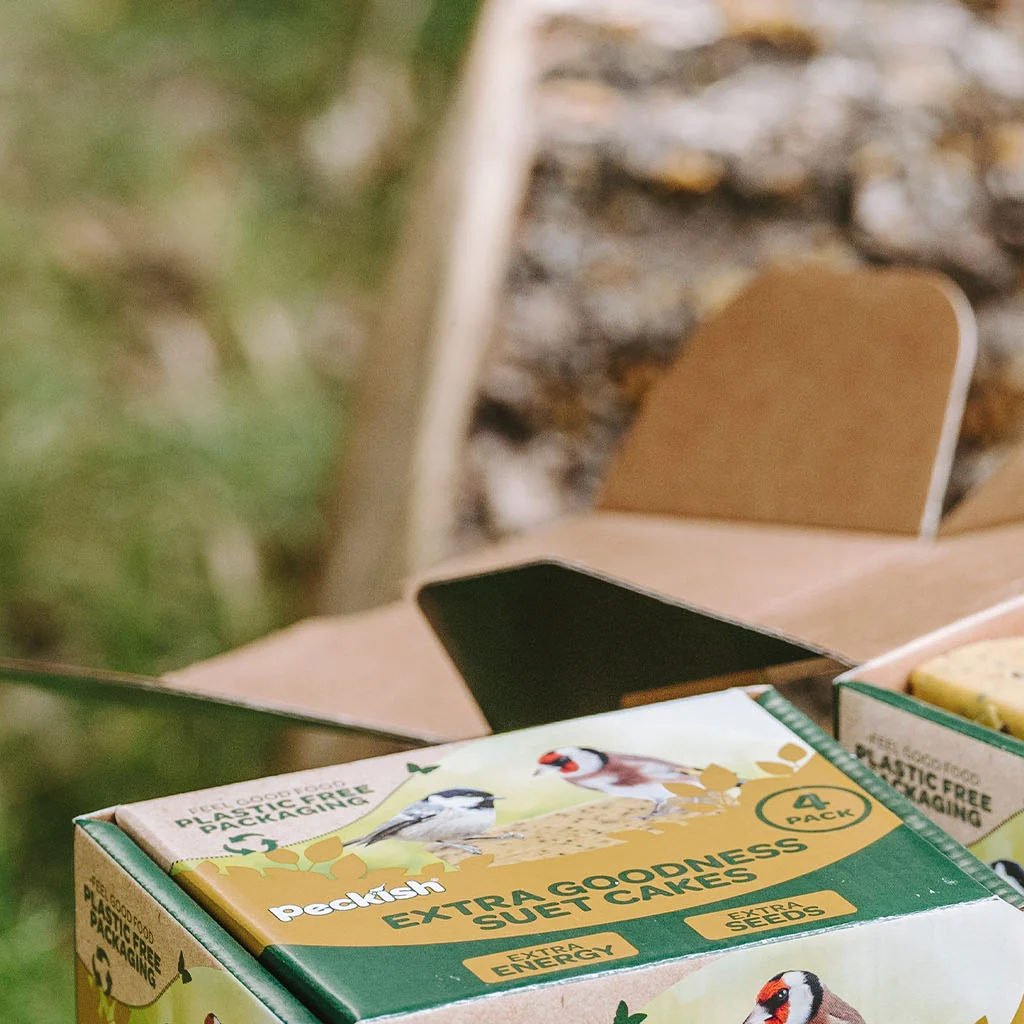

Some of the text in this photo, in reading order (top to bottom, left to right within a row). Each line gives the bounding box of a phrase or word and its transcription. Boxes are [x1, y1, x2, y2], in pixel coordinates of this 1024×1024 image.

[855, 743, 992, 813] PLASTIC FREE
[903, 745, 939, 771] GOOD
[944, 762, 980, 785] FOOD
[175, 784, 374, 828] PLASTIC FREE
[188, 780, 346, 815] FEEL GOOD FOOD
[200, 796, 369, 834] PACKAGING
[786, 808, 855, 824] PACK
[793, 793, 830, 810] 4
[381, 837, 808, 930] EXTRA GOODNESS
[472, 867, 757, 931] SUET CAKES
[83, 883, 161, 975] PLASTIC FREE
[90, 875, 154, 944] FEEL GOOD FOOD
[724, 905, 825, 931] SEEDS
[727, 900, 803, 920] EXTRA
[90, 910, 156, 989] PACKAGING
[496, 943, 616, 977] ENERGY
[507, 943, 584, 962] EXTRA
